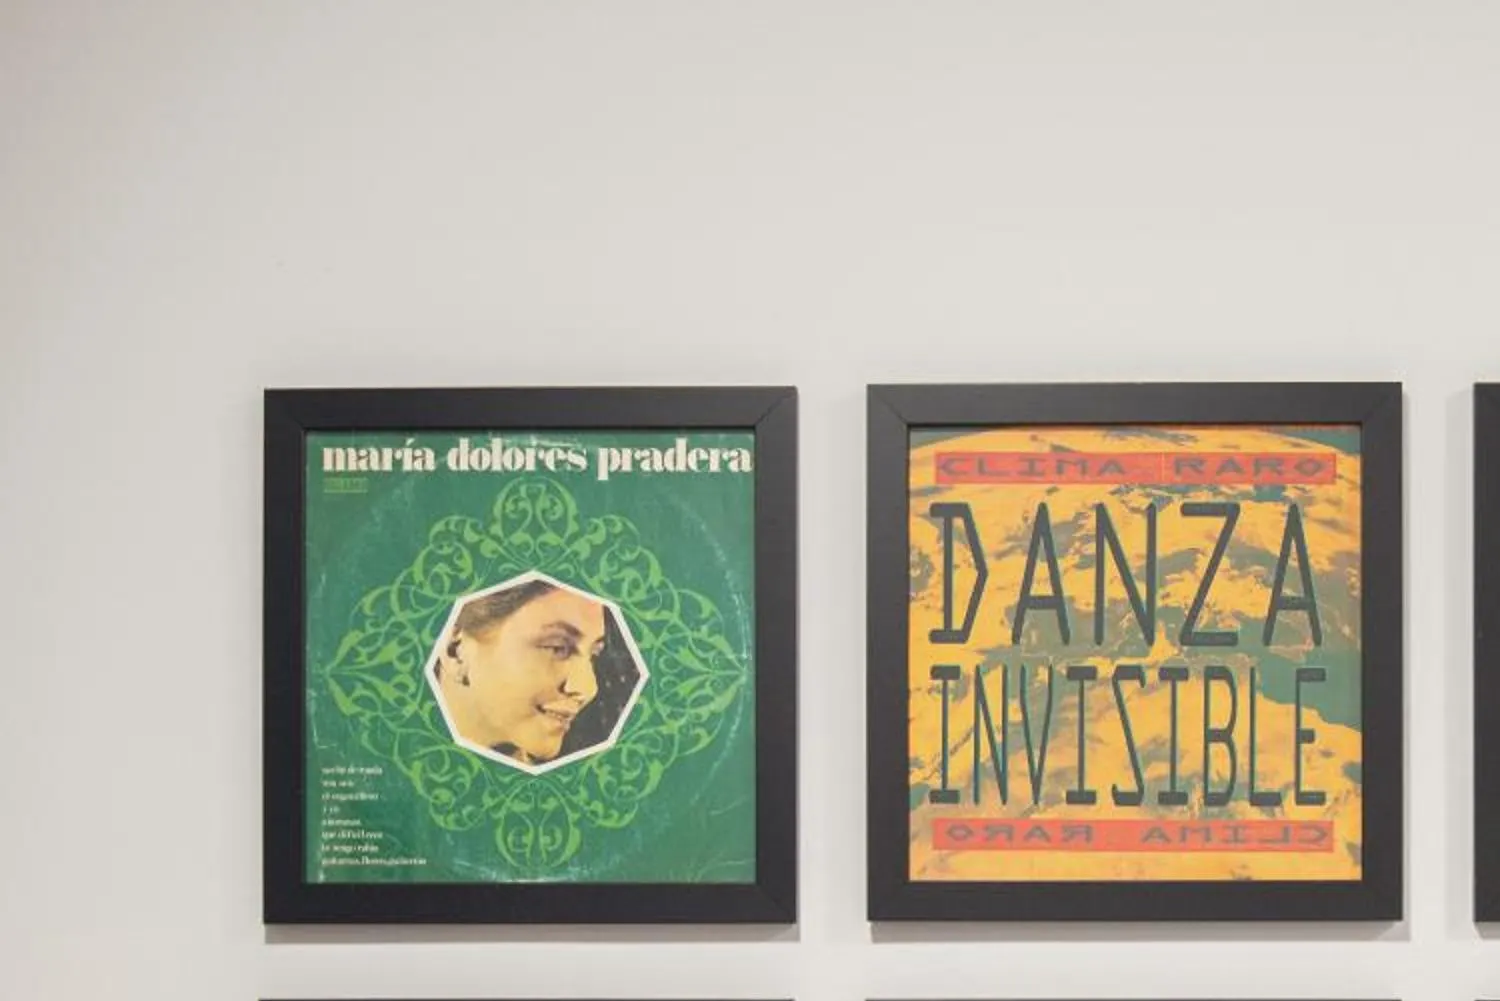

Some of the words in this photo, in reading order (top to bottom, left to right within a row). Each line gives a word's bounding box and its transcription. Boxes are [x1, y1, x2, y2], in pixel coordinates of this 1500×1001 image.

[323, 439, 436, 473] maría
[446, 438, 588, 473] dolores
[597, 438, 753, 480] pradera
[939, 456, 1127, 479] CLIMA
[1173, 456, 1326, 479] RARO
[929, 501, 1322, 647] DANZA
[929, 664, 1327, 807] INVISIBLE
